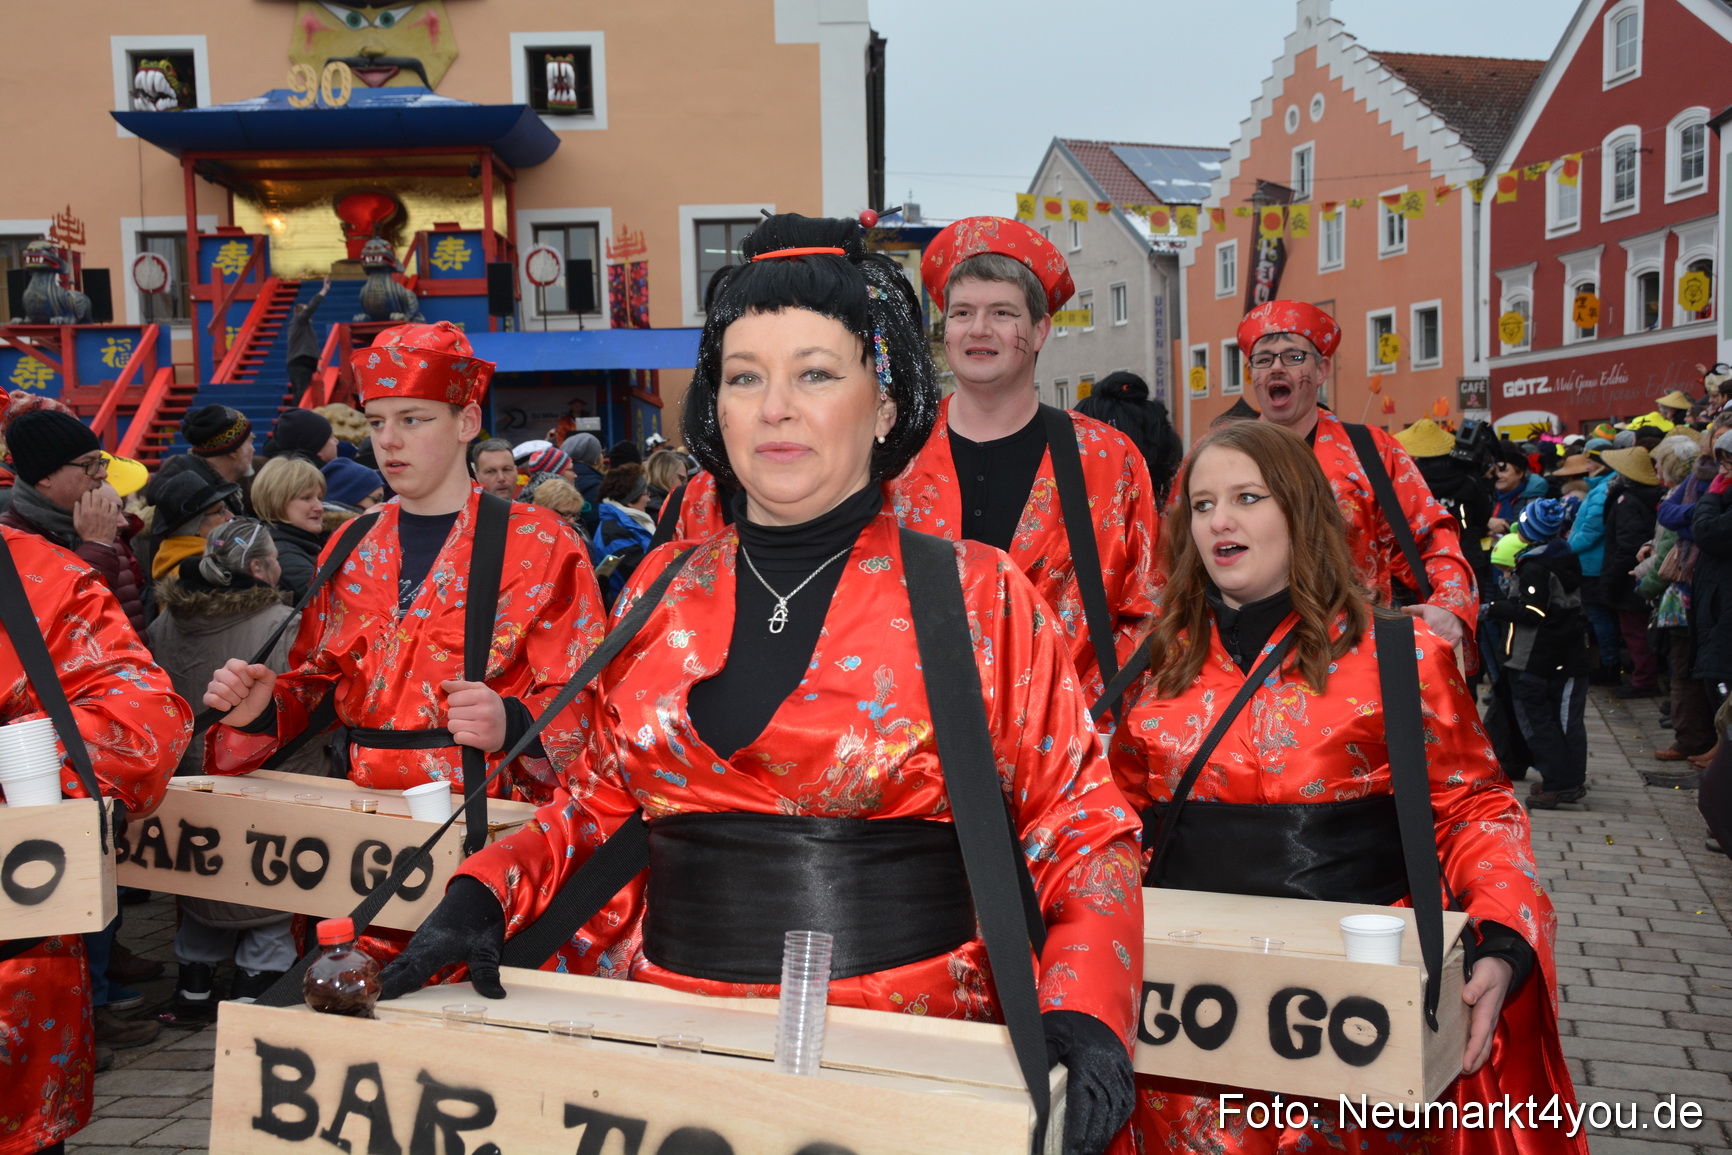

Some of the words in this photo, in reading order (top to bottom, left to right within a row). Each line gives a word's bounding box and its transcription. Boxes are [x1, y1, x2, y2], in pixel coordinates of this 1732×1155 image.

[287, 60, 353, 109] 90
[1154, 296, 1163, 349] UHREN
[1460, 380, 1486, 394] CAFÉ
[246, 830, 330, 890] TO
[350, 839, 434, 902] GO
[1268, 987, 1391, 1067] GO
[252, 1037, 503, 1155] BAR
